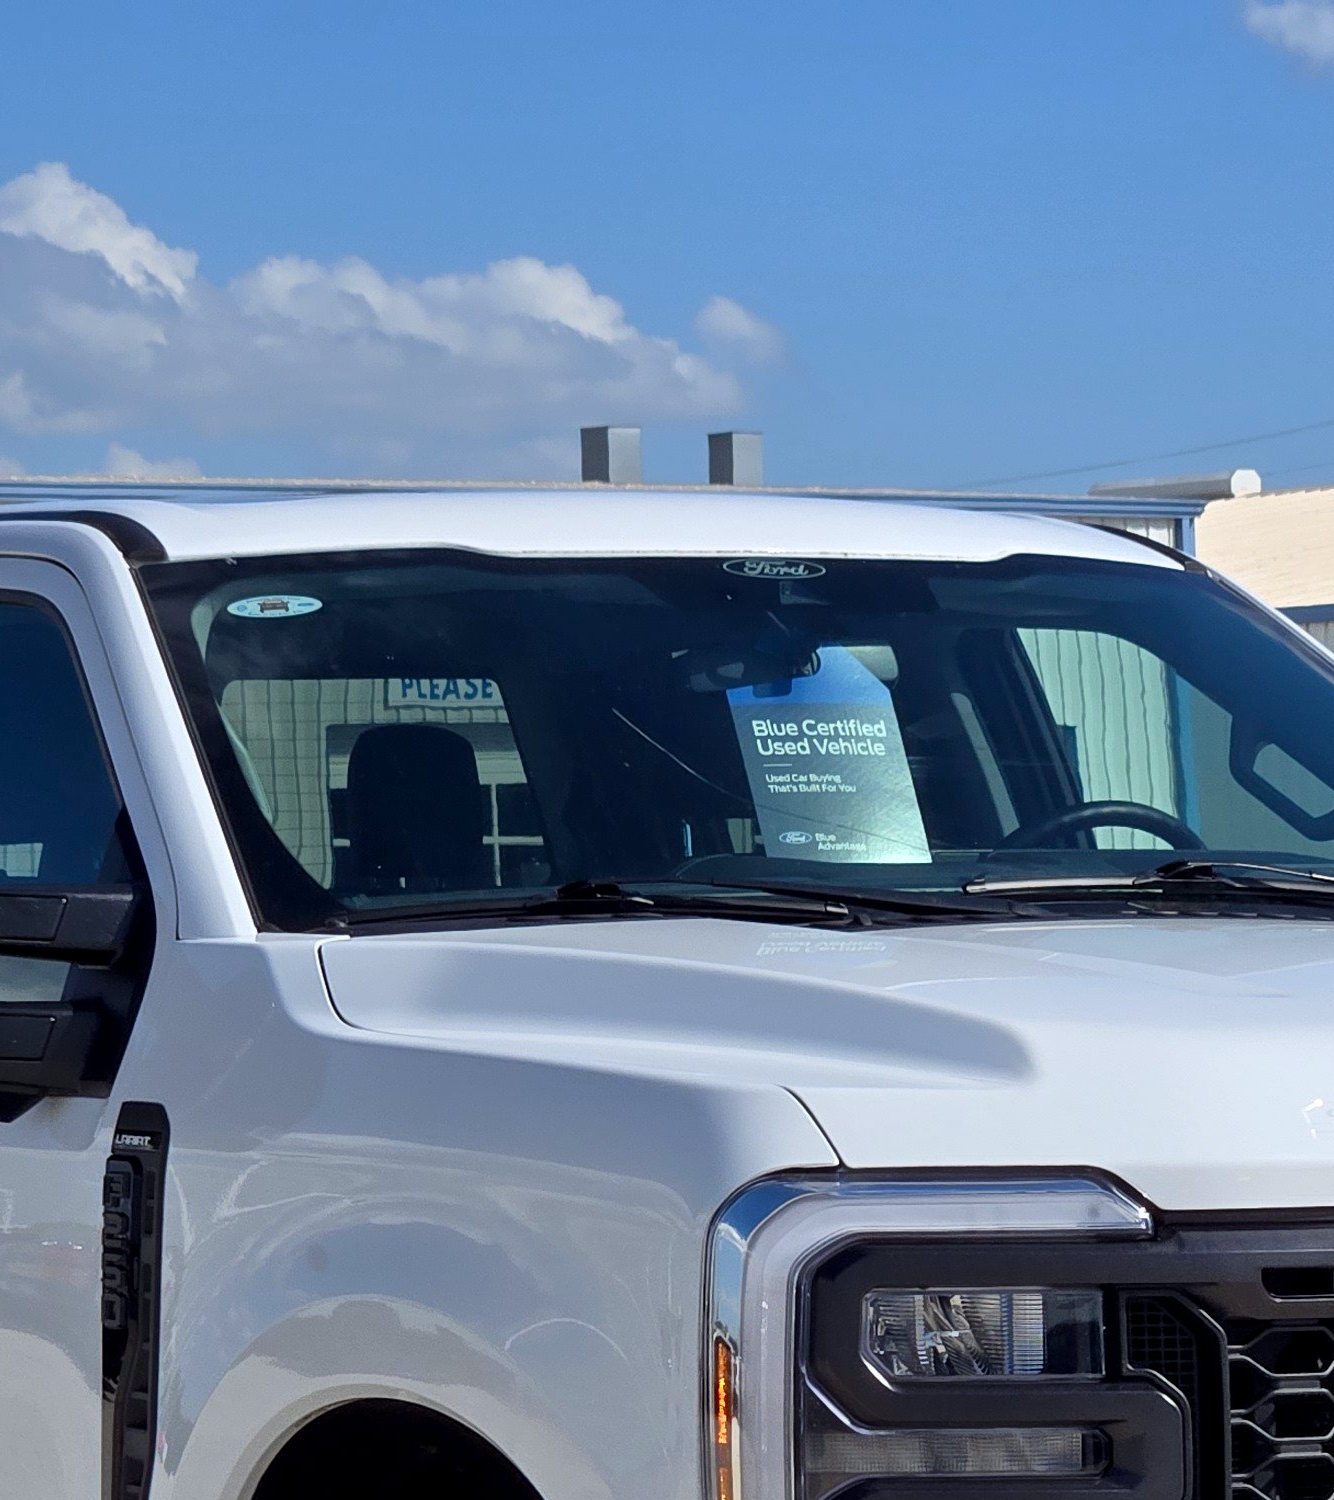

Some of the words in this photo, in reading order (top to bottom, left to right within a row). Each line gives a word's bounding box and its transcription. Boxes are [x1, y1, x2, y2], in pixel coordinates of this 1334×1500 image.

[744, 560, 809, 576] Ford
[401, 678, 494, 700] PLEASE
[751, 719, 799, 737] Blue
[802, 719, 887, 738] Certified
[756, 738, 810, 756] Used
[813, 738, 886, 756] Vehicle
[765, 774, 791, 783] Used
[792, 774, 808, 783] Car
[809, 774, 842, 785] Buying
[768, 784, 798, 793] That's
[838, 784, 857, 793] You
